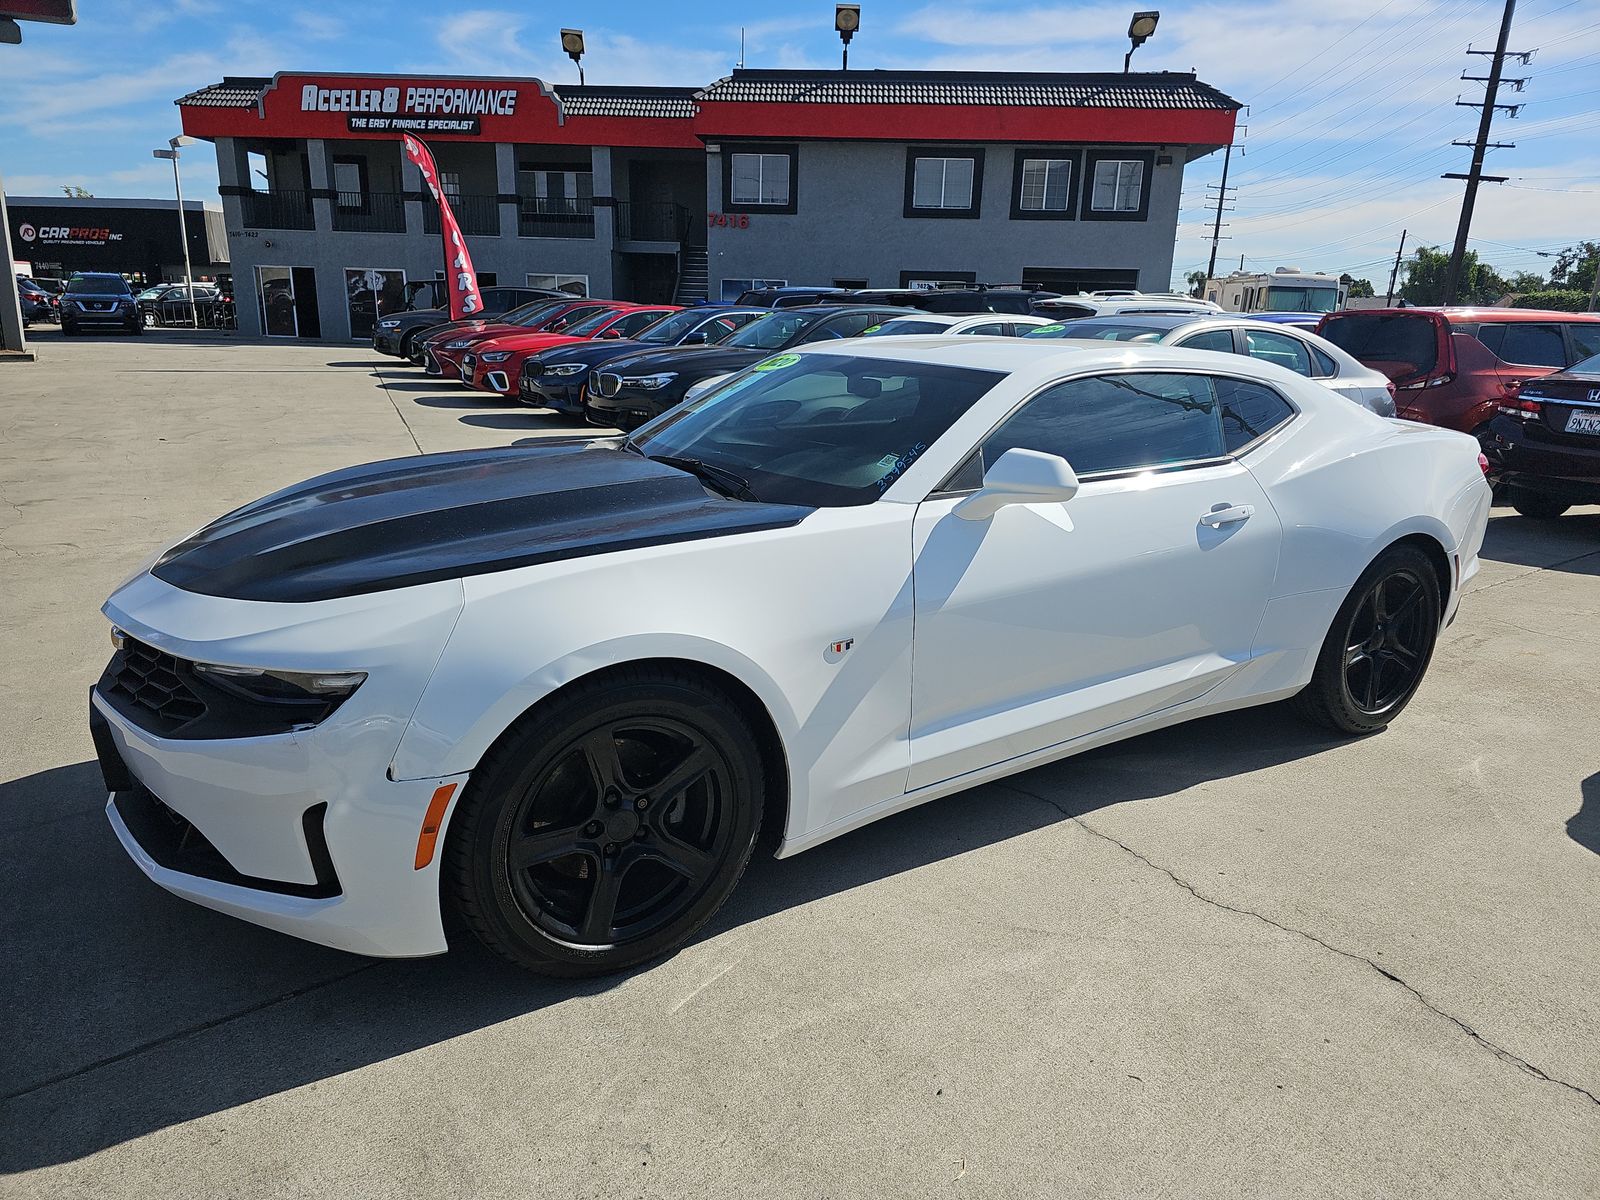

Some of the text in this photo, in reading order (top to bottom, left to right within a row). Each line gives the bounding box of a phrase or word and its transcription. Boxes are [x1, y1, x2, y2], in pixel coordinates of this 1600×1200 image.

[301, 85, 517, 115] ACCELER8 PERFORMANCE
[351, 118, 474, 131] THE EASY FINANCE SPECIALIST
[708, 212, 750, 230] 7416
[108, 233, 123, 241] INC
[876, 441, 927, 492] 3599545
